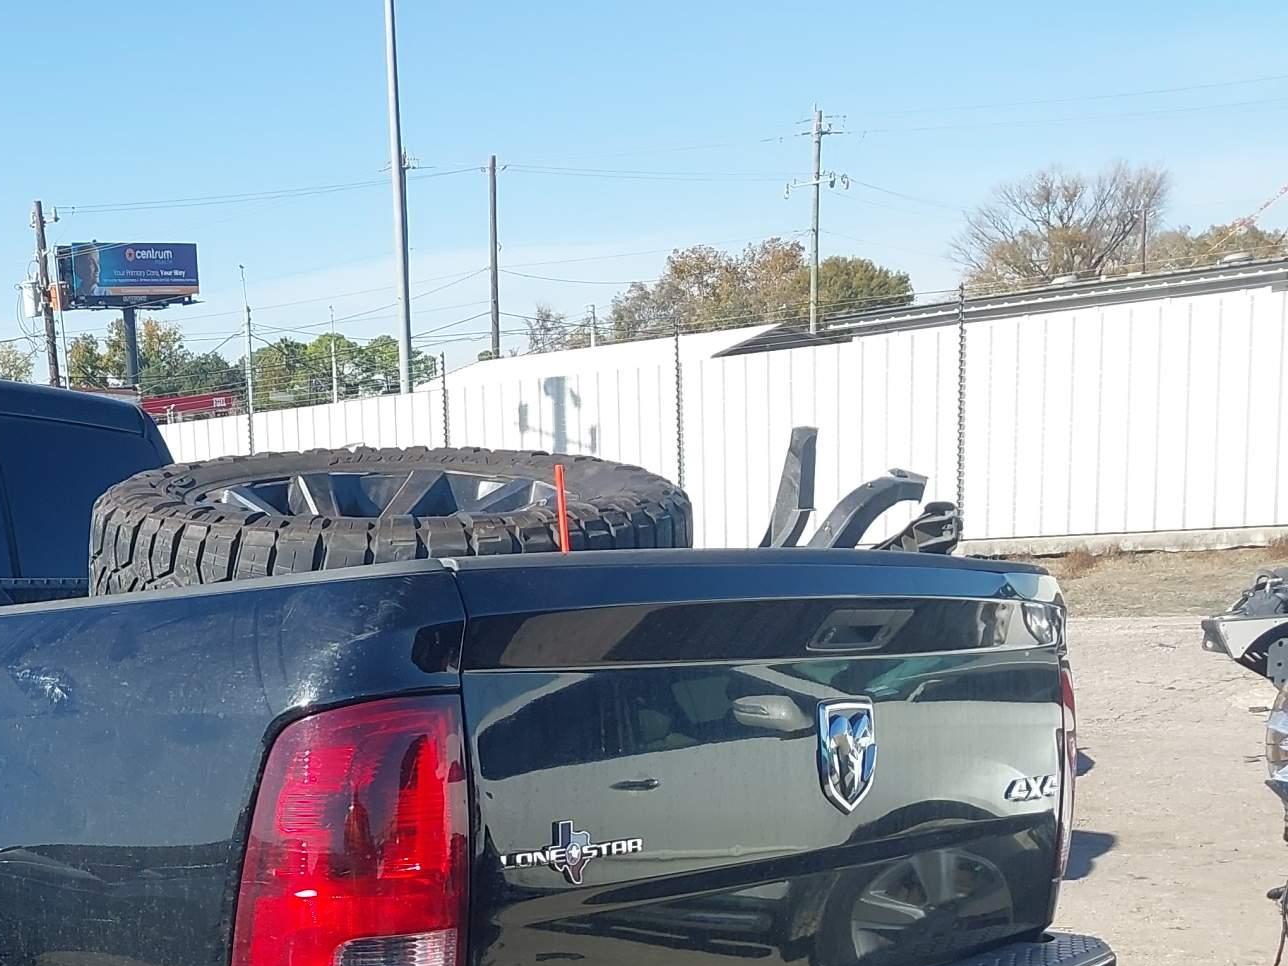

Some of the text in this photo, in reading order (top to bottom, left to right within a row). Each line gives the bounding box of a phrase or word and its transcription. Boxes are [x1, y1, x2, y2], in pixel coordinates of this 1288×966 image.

[135, 247, 173, 260] centrum
[499, 838, 643, 870] LONE STAR
